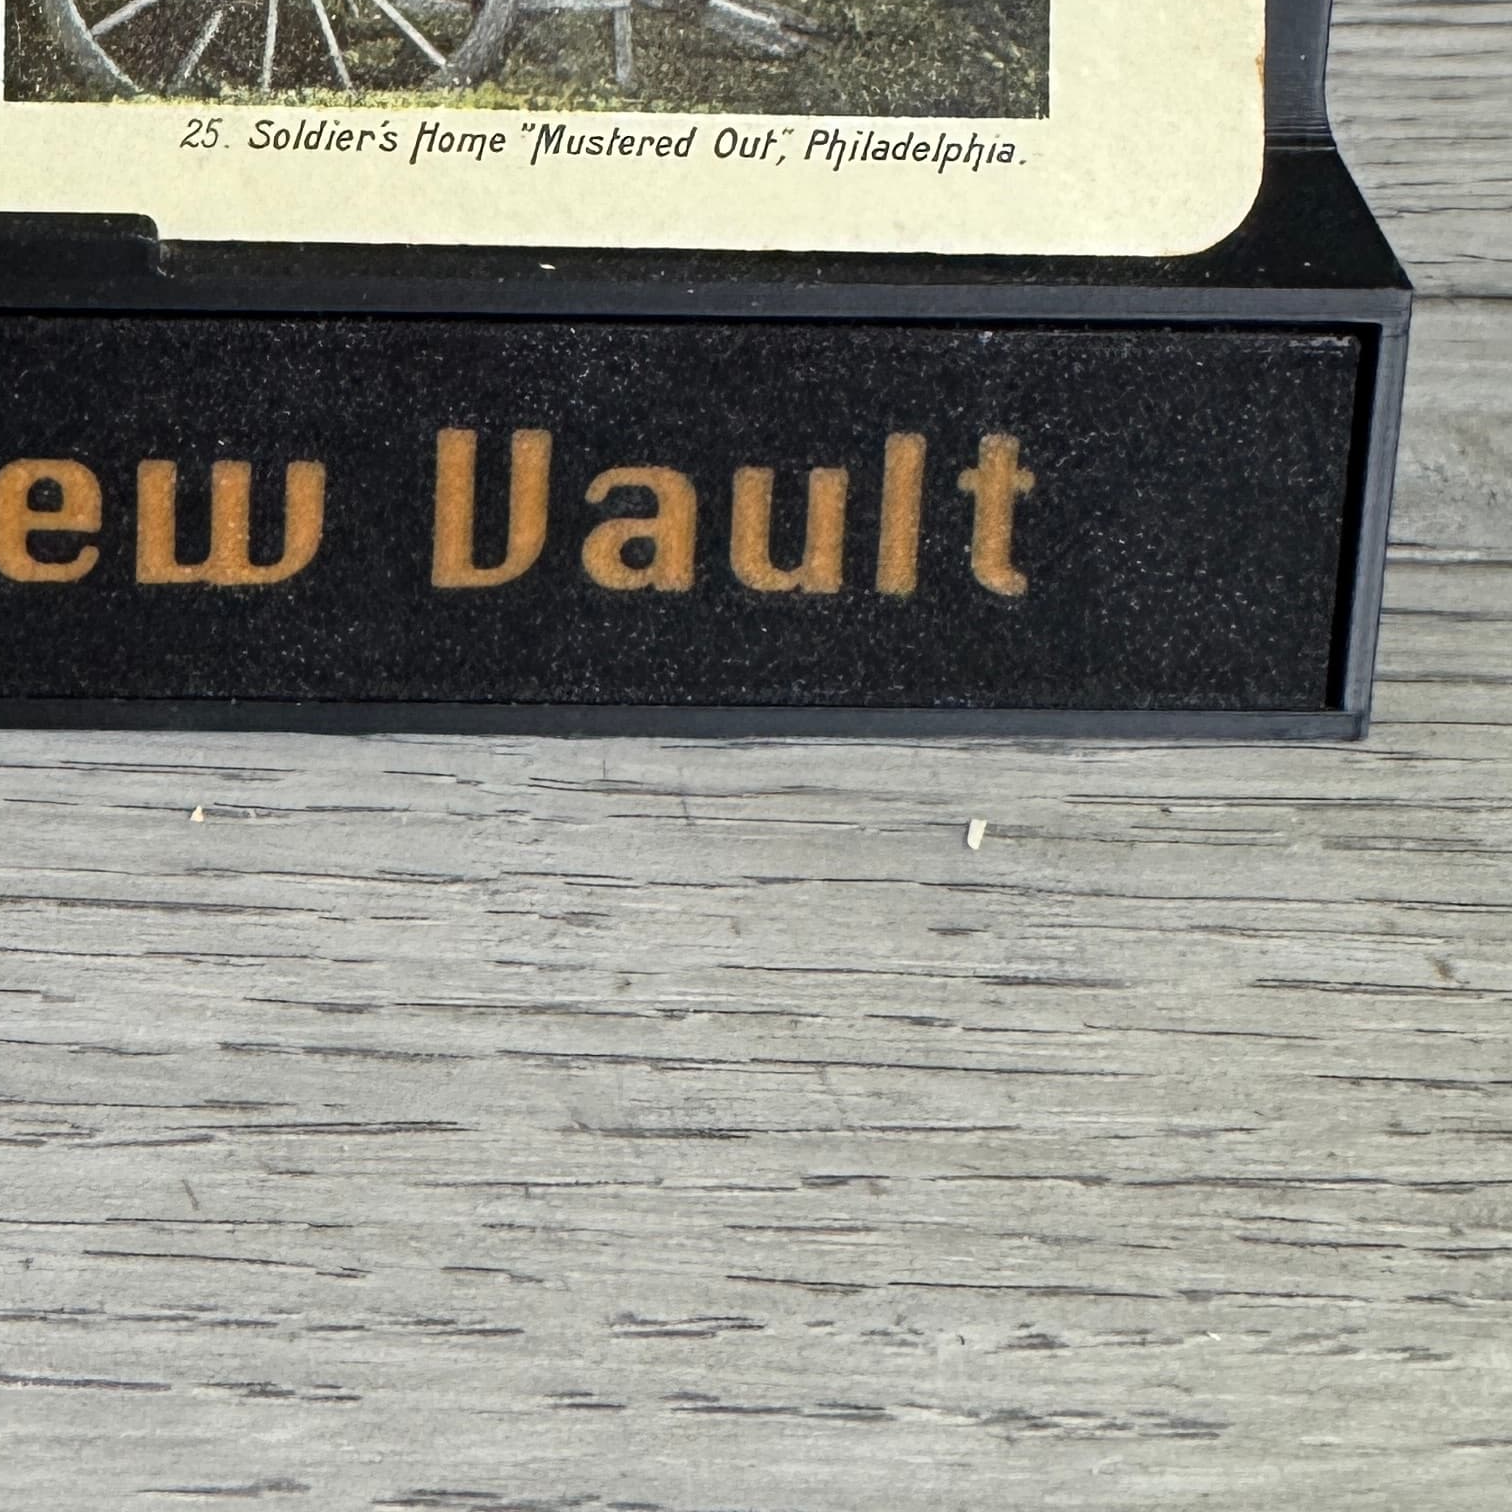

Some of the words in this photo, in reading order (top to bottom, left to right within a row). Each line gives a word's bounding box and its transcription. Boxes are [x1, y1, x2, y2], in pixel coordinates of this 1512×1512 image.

[179, 118, 230, 150] 25.
[247, 119, 398, 153] Soldier's
[409, 121, 506, 165] Home
[803, 128, 1028, 175] Philadelphia.
[432, 428, 1040, 600] Vault
